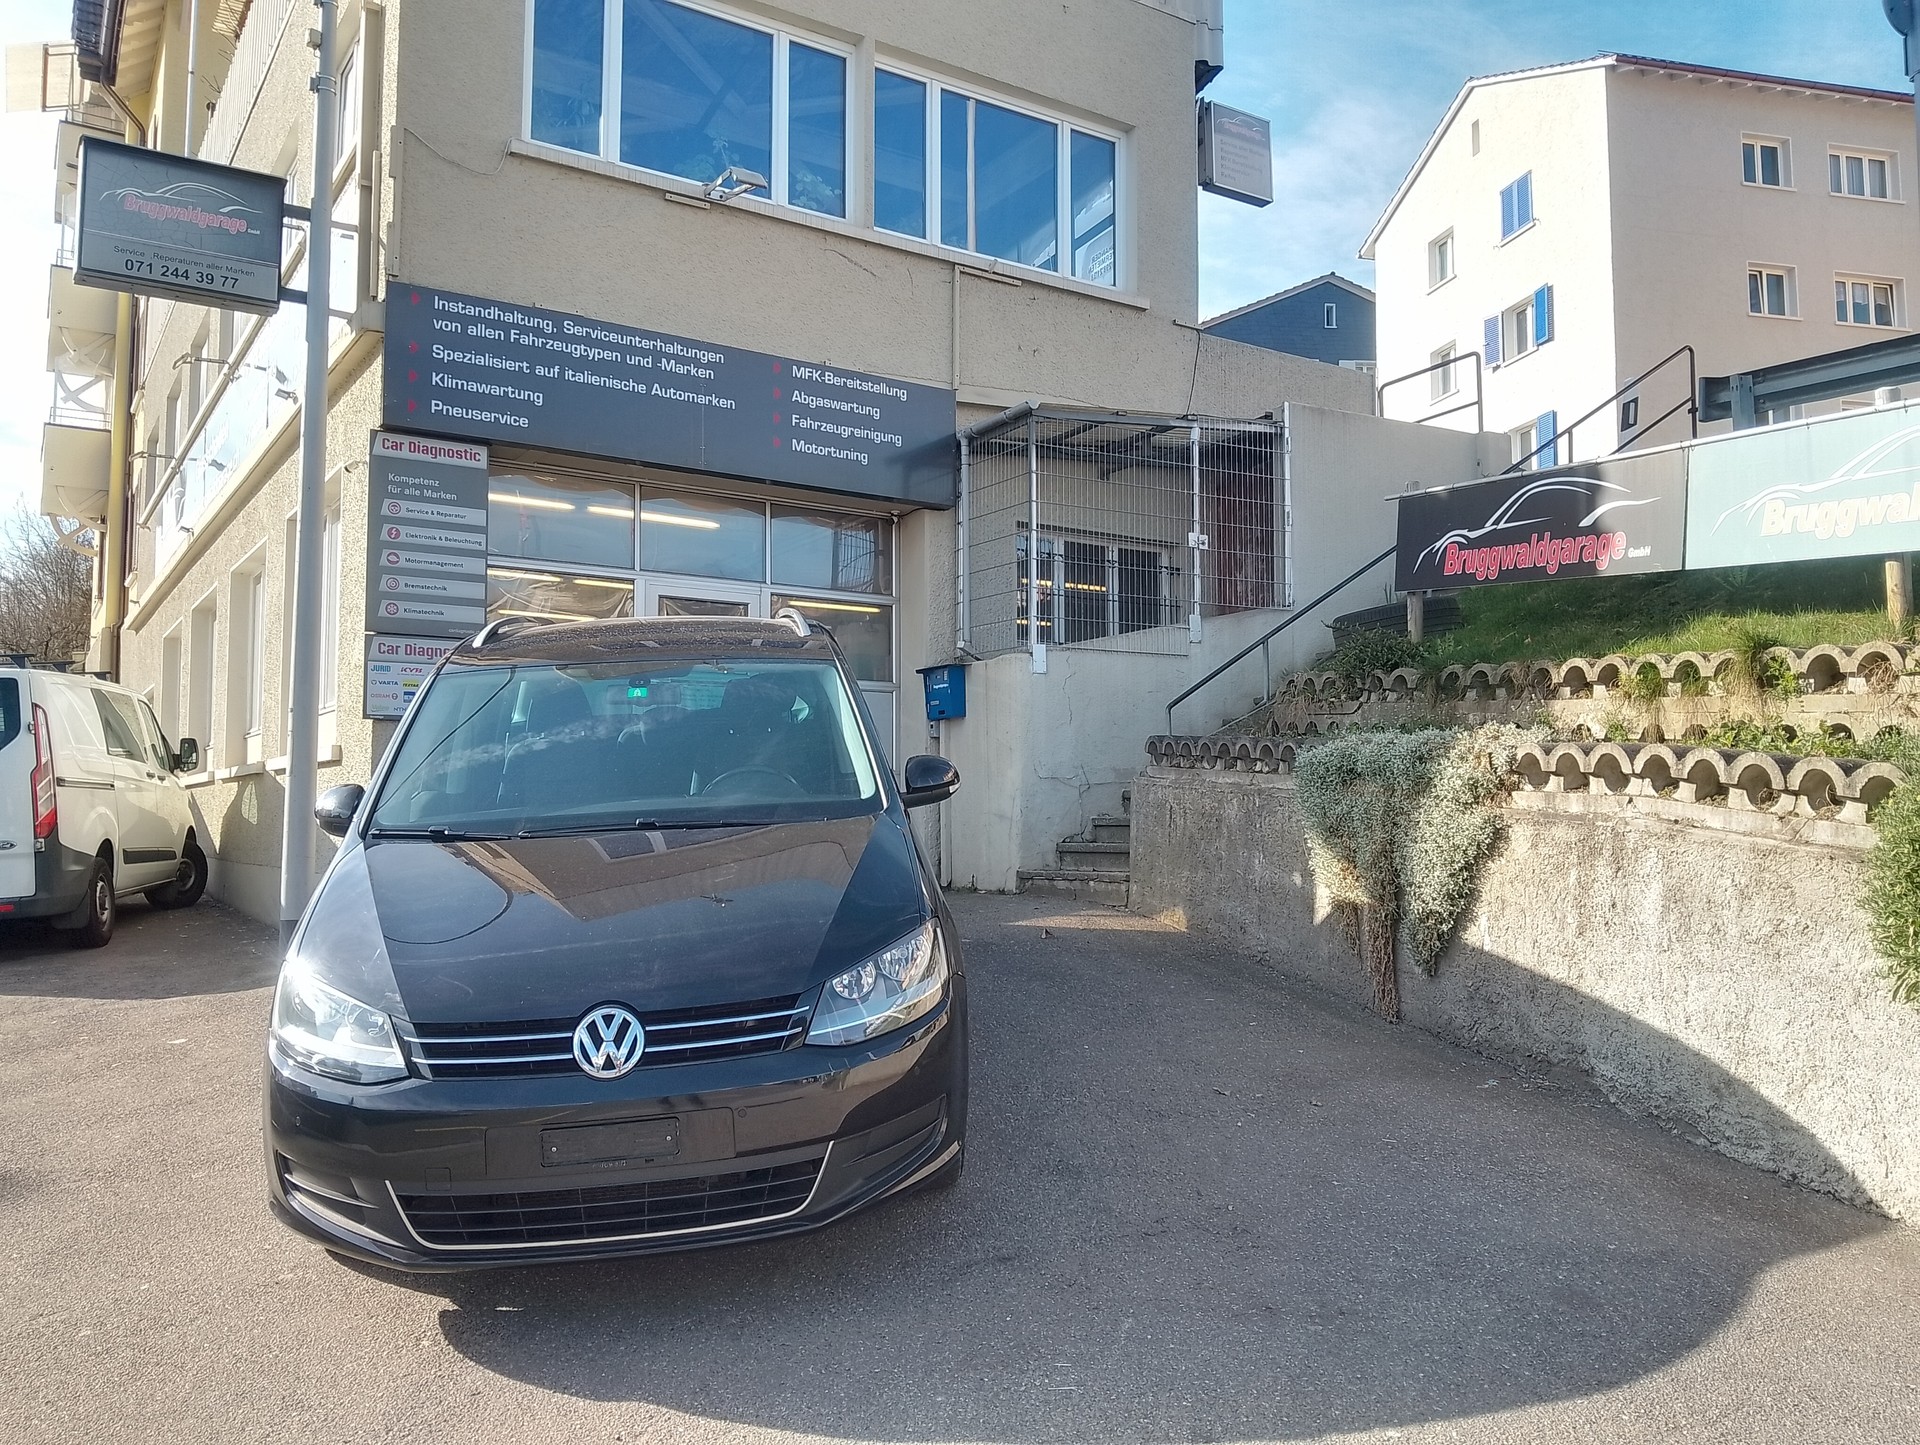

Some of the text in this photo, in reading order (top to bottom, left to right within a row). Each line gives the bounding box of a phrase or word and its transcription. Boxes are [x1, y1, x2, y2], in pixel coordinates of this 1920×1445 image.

[123, 193, 248, 234] Bruggwaldgarage
[113, 245, 146, 258] Service
[205, 262, 224, 271] aller
[225, 265, 256, 278] Marken
[124, 258, 239, 289] 071 244 39 77
[433, 295, 725, 364] Instandhaltung, Serviceunterhaltungen
[432, 317, 715, 380] von allen Fahrzeugtypen und -Marken
[431, 344, 736, 410] Spezialisiert auf italienische Automarken
[431, 371, 544, 407] Klimawartung
[791, 364, 908, 402] MFK-Bereitstellung
[430, 400, 529, 428] Pneuservice
[791, 389, 881, 420] Abgaswartung
[791, 414, 903, 448] Fahrzeugreinigung
[381, 437, 482, 462] Car Diagnostic
[791, 438, 869, 466] Motortuning
[387, 484, 458, 501] für alle Marken
[388, 472, 440, 488] Kompetenz
[405, 506, 430, 516] Service
[436, 510, 467, 520] Reparatur
[405, 531, 438, 541] Elektronik
[444, 536, 483, 547] Beleuchtung
[404, 557, 465, 569] Motormanagement
[1444, 531, 1652, 580] Bruggwaldgarage GmbH
[404, 582, 448, 592] Bremstechnik
[403, 607, 445, 616] Klimatechnik
[377, 642, 402, 656] Car
[370, 665, 391, 673] JURID
